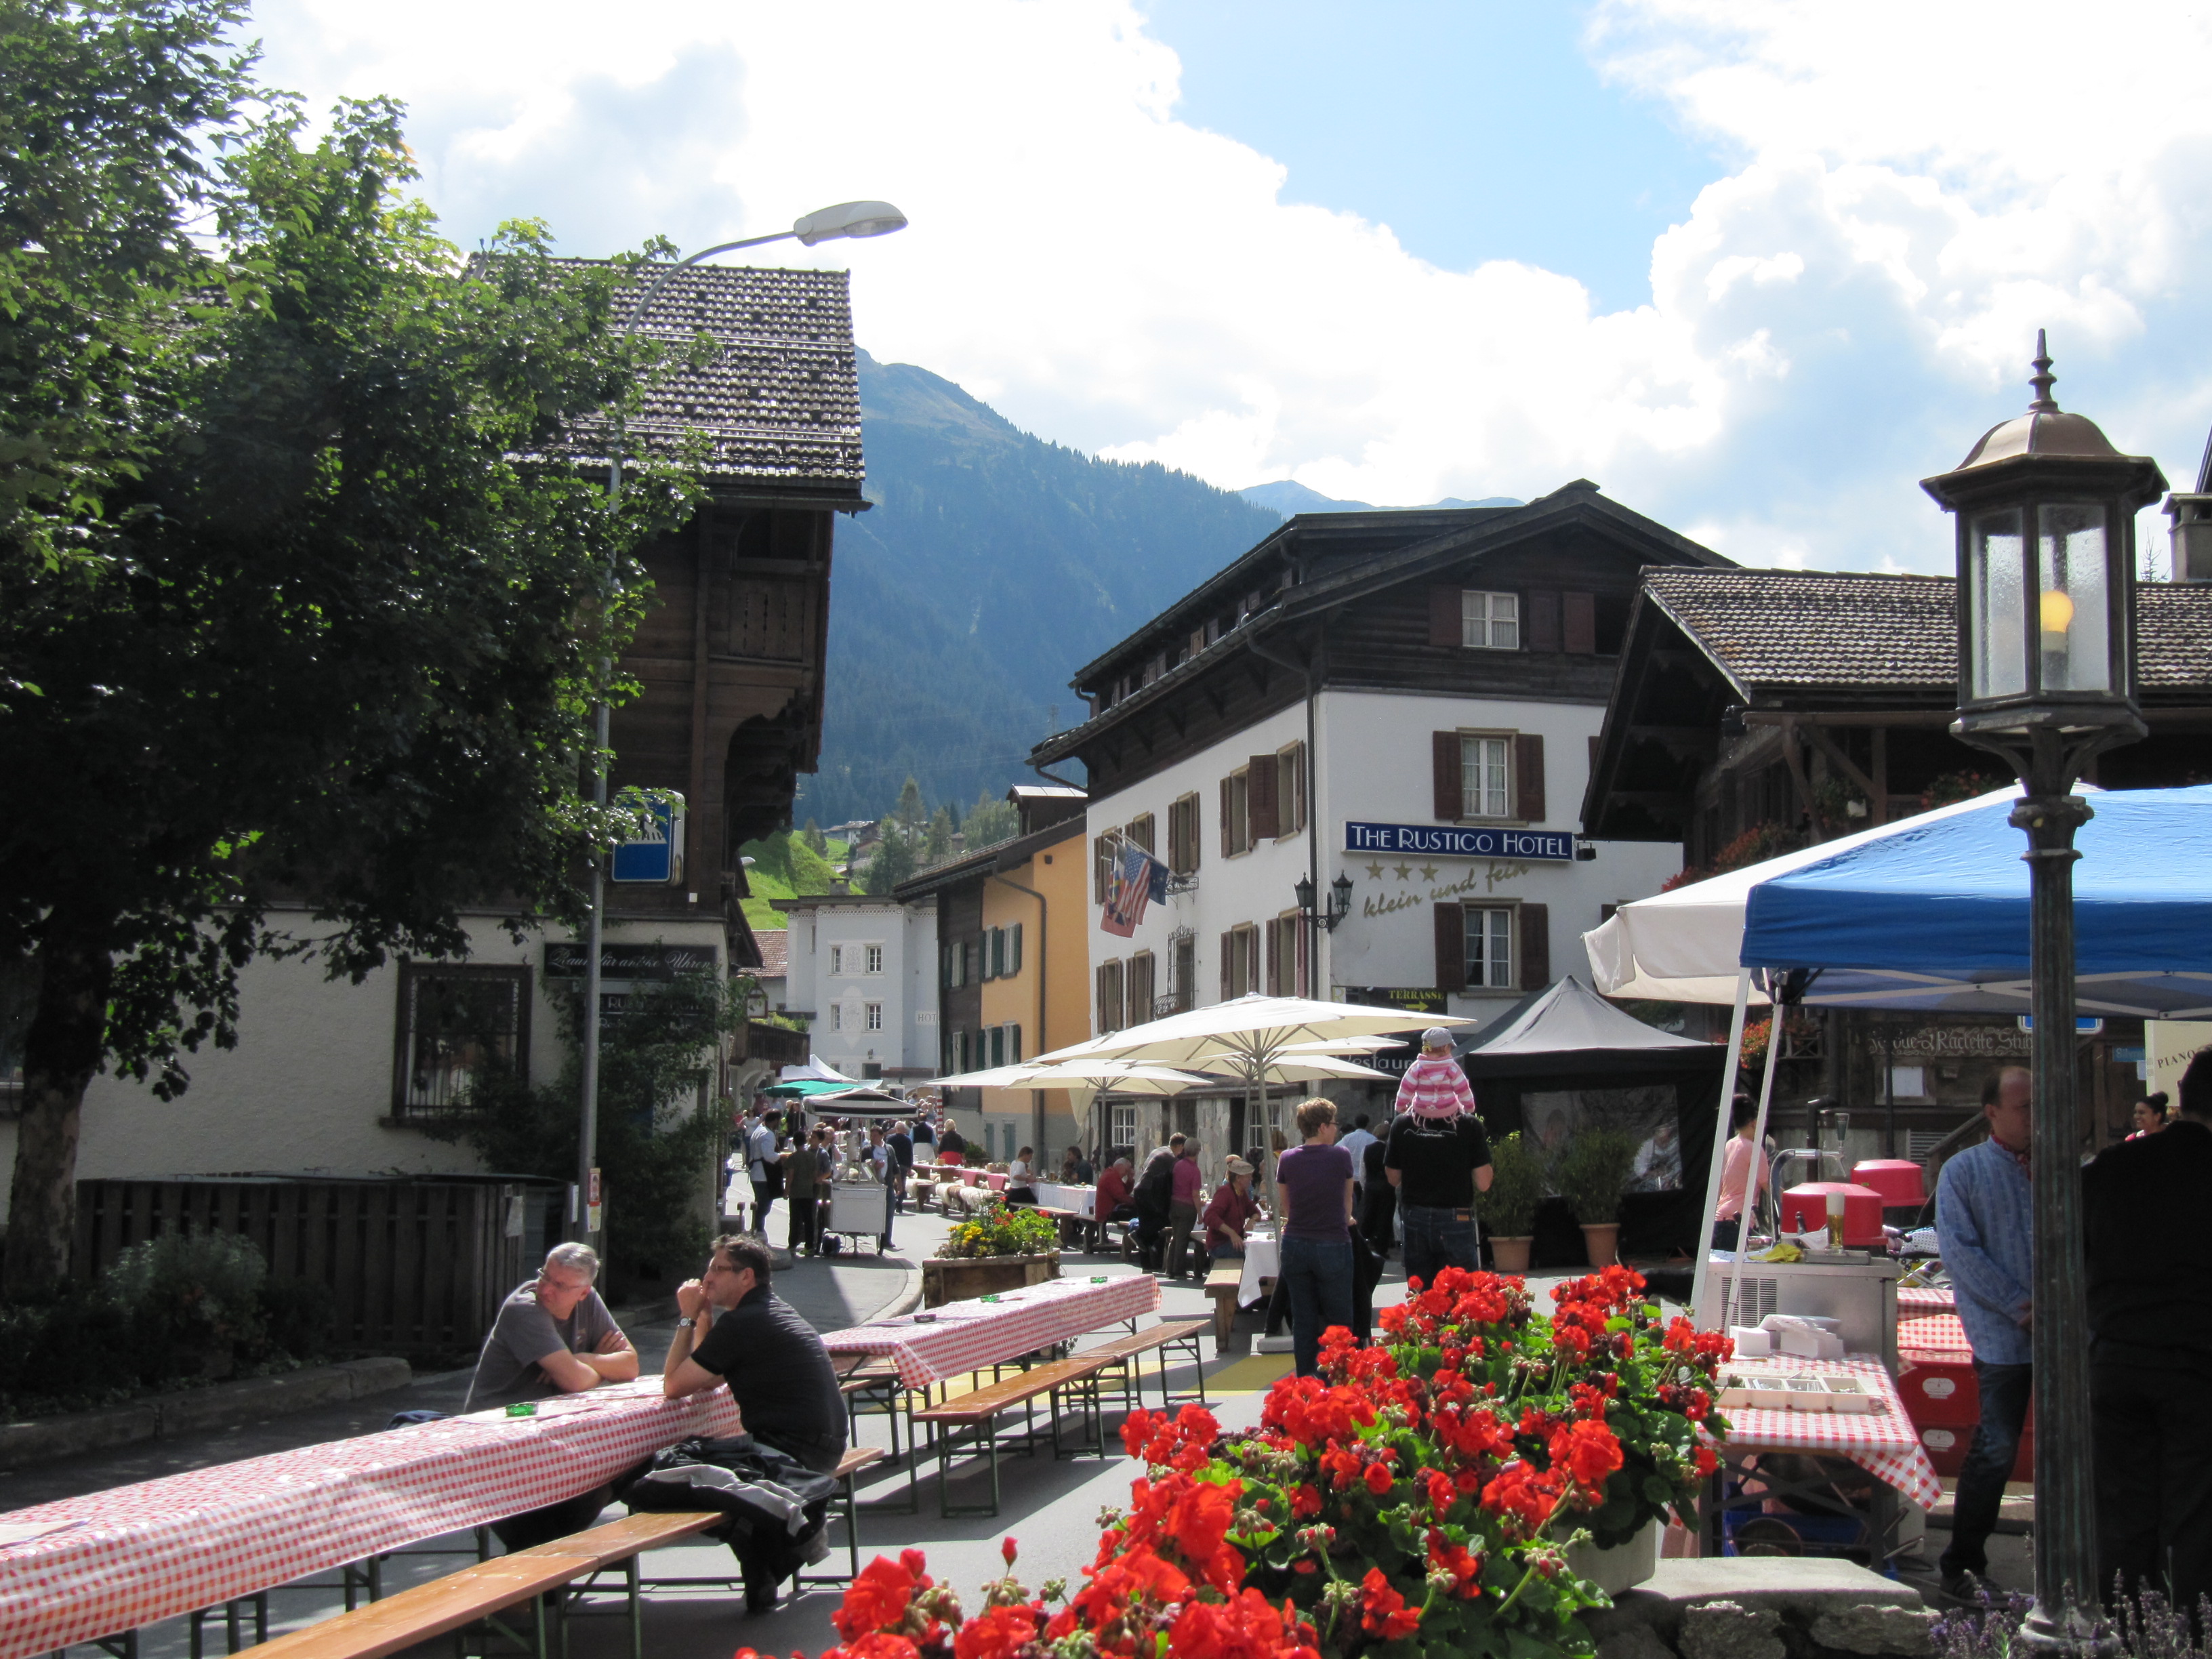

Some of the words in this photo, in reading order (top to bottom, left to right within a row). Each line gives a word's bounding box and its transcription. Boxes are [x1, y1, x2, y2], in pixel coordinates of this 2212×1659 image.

[1351, 825, 1391, 848] THE
[1398, 828, 1493, 853] RUSTICO
[1503, 833, 1568, 855] HOTEL
[1363, 890, 1422, 918] klein
[1430, 867, 1477, 900] und
[1485, 859, 1530, 893] fein
[1389, 989, 1445, 1000] TERRASSE
[1937, 1030, 1994, 1051] Raclette
